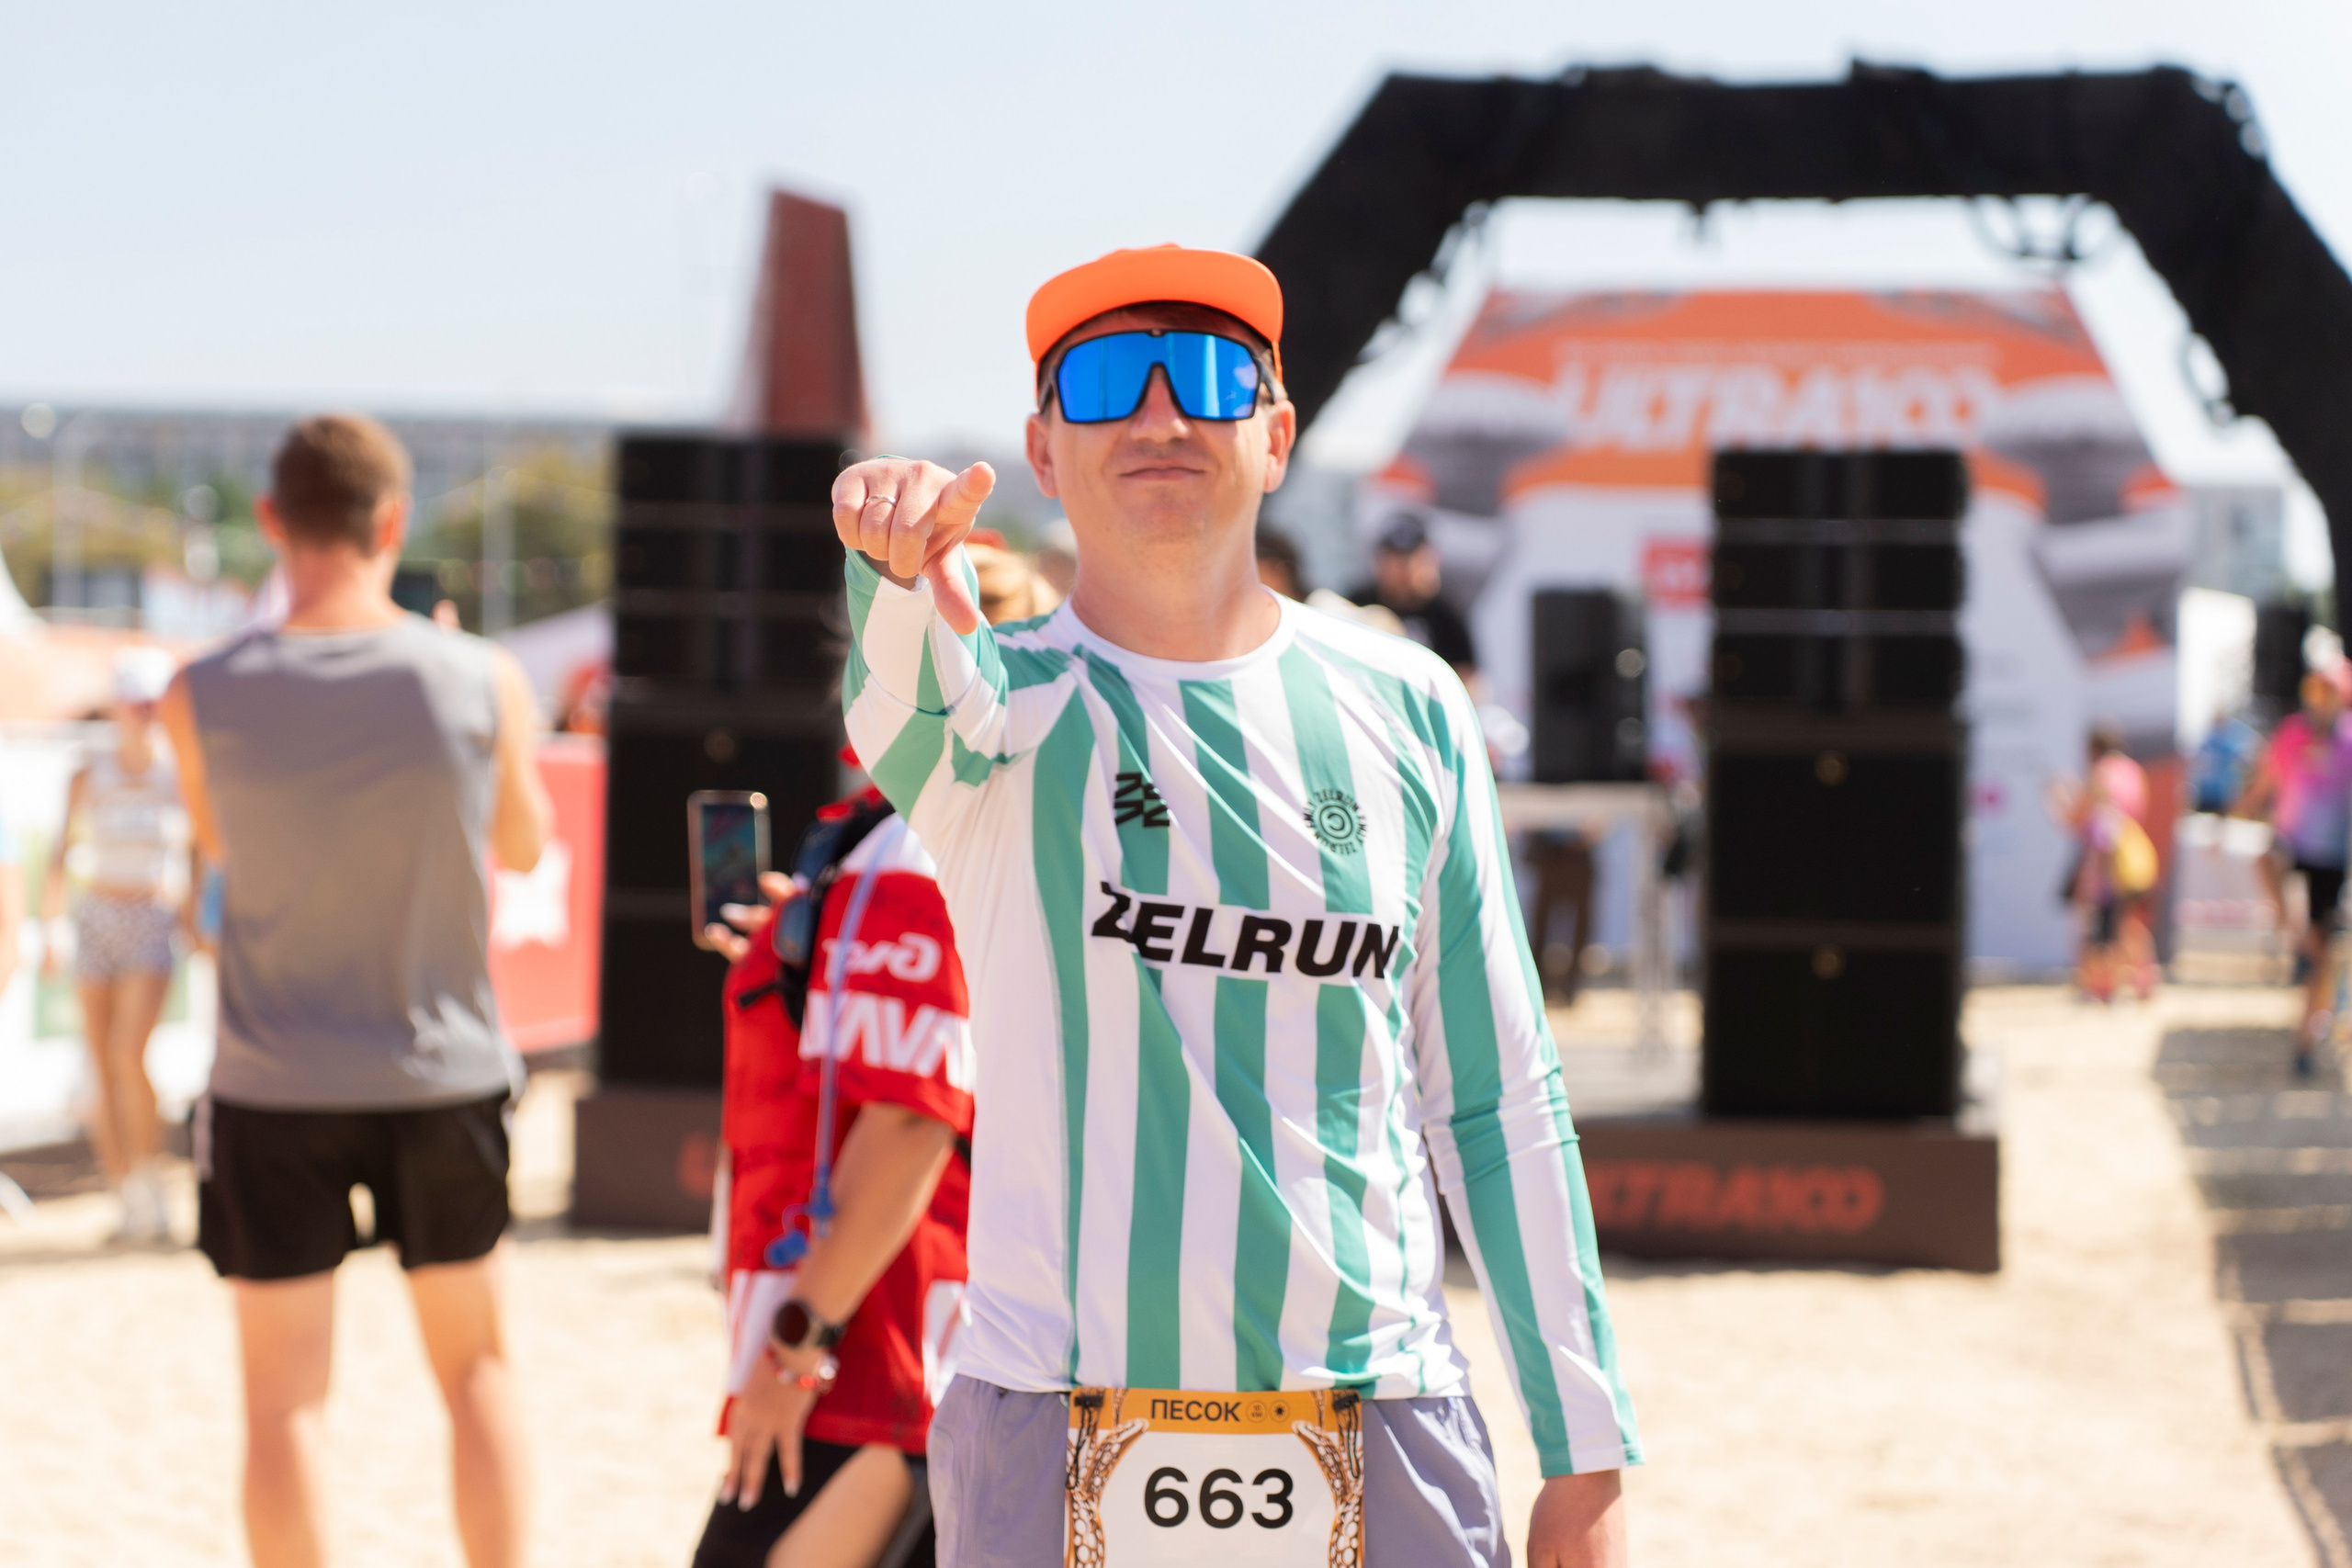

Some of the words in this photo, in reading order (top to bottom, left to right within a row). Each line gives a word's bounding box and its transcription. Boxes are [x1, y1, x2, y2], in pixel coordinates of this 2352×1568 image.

[1091, 880, 1400, 979] ZELRUN
[1150, 1398, 1241, 1422] ПЕСОК
[1144, 1466, 1295, 1529] 663
